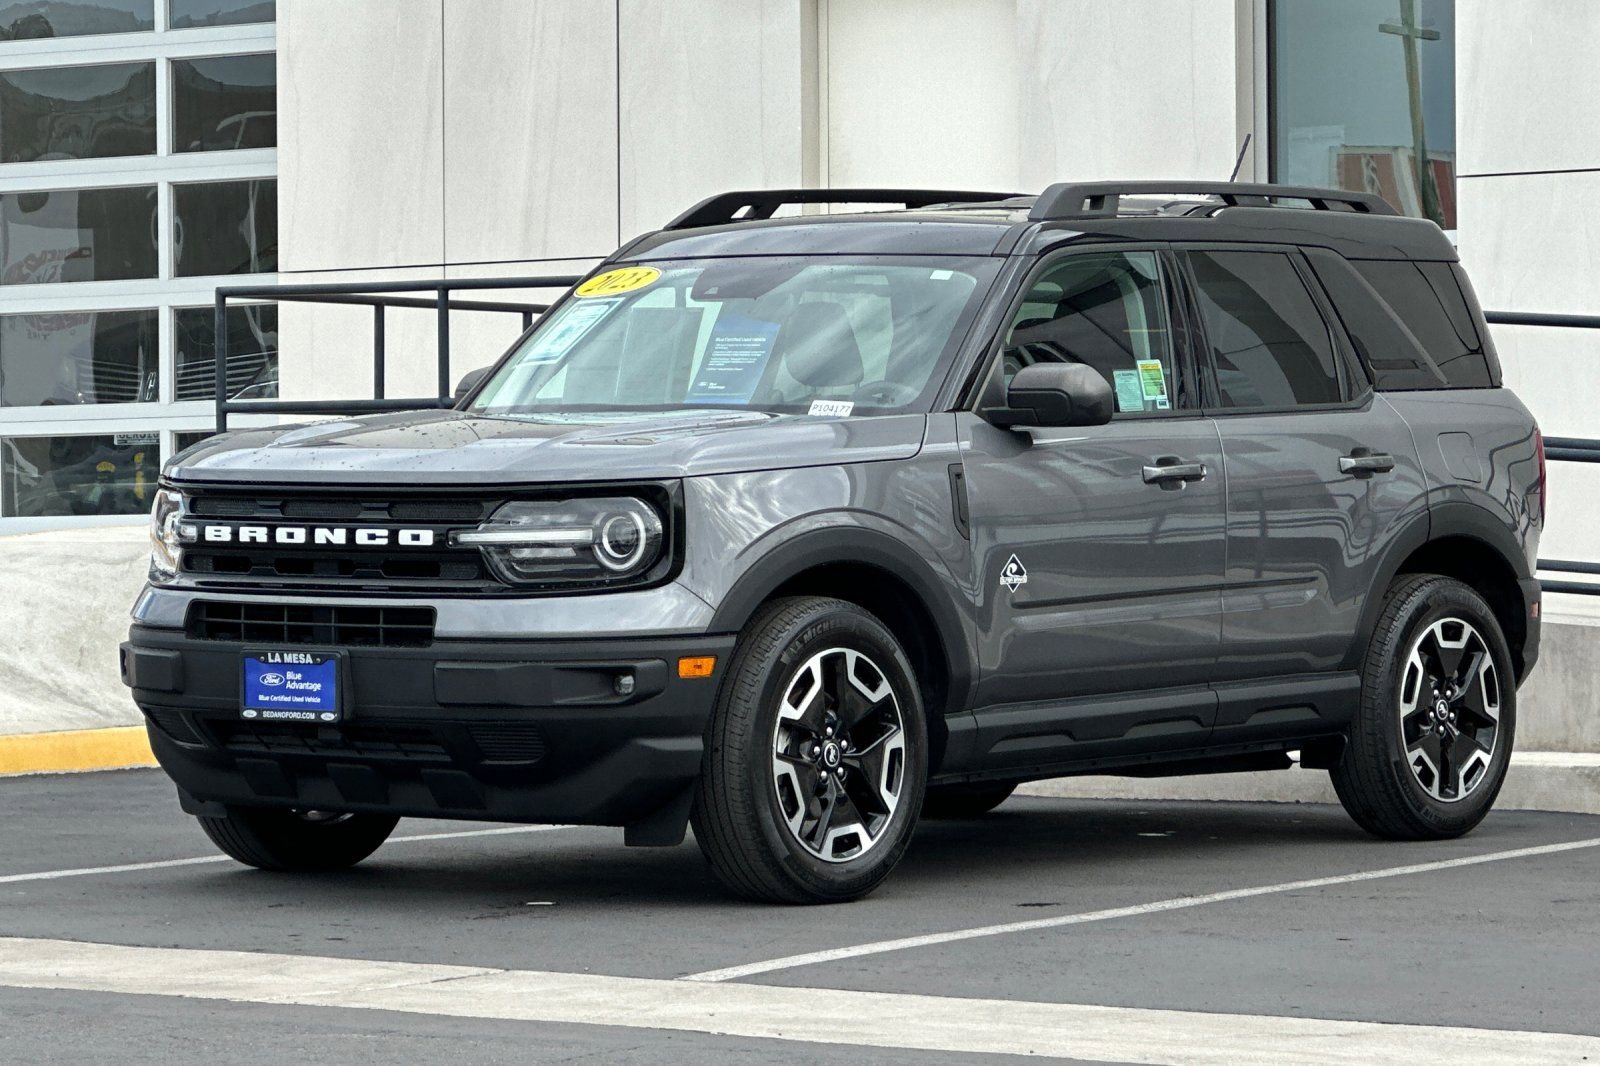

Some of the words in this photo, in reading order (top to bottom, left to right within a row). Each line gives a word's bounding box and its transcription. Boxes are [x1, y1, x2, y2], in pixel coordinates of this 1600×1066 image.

[581, 271, 653, 293] 2023
[204, 525, 434, 546] BRONCO
[267, 652, 282, 663] LA
[283, 653, 313, 664] MESA
[286, 671, 302, 680] Blue
[285, 680, 322, 692] Advantage
[270, 694, 292, 702] Certified
[262, 710, 316, 720] SEDANOFORD.COM
